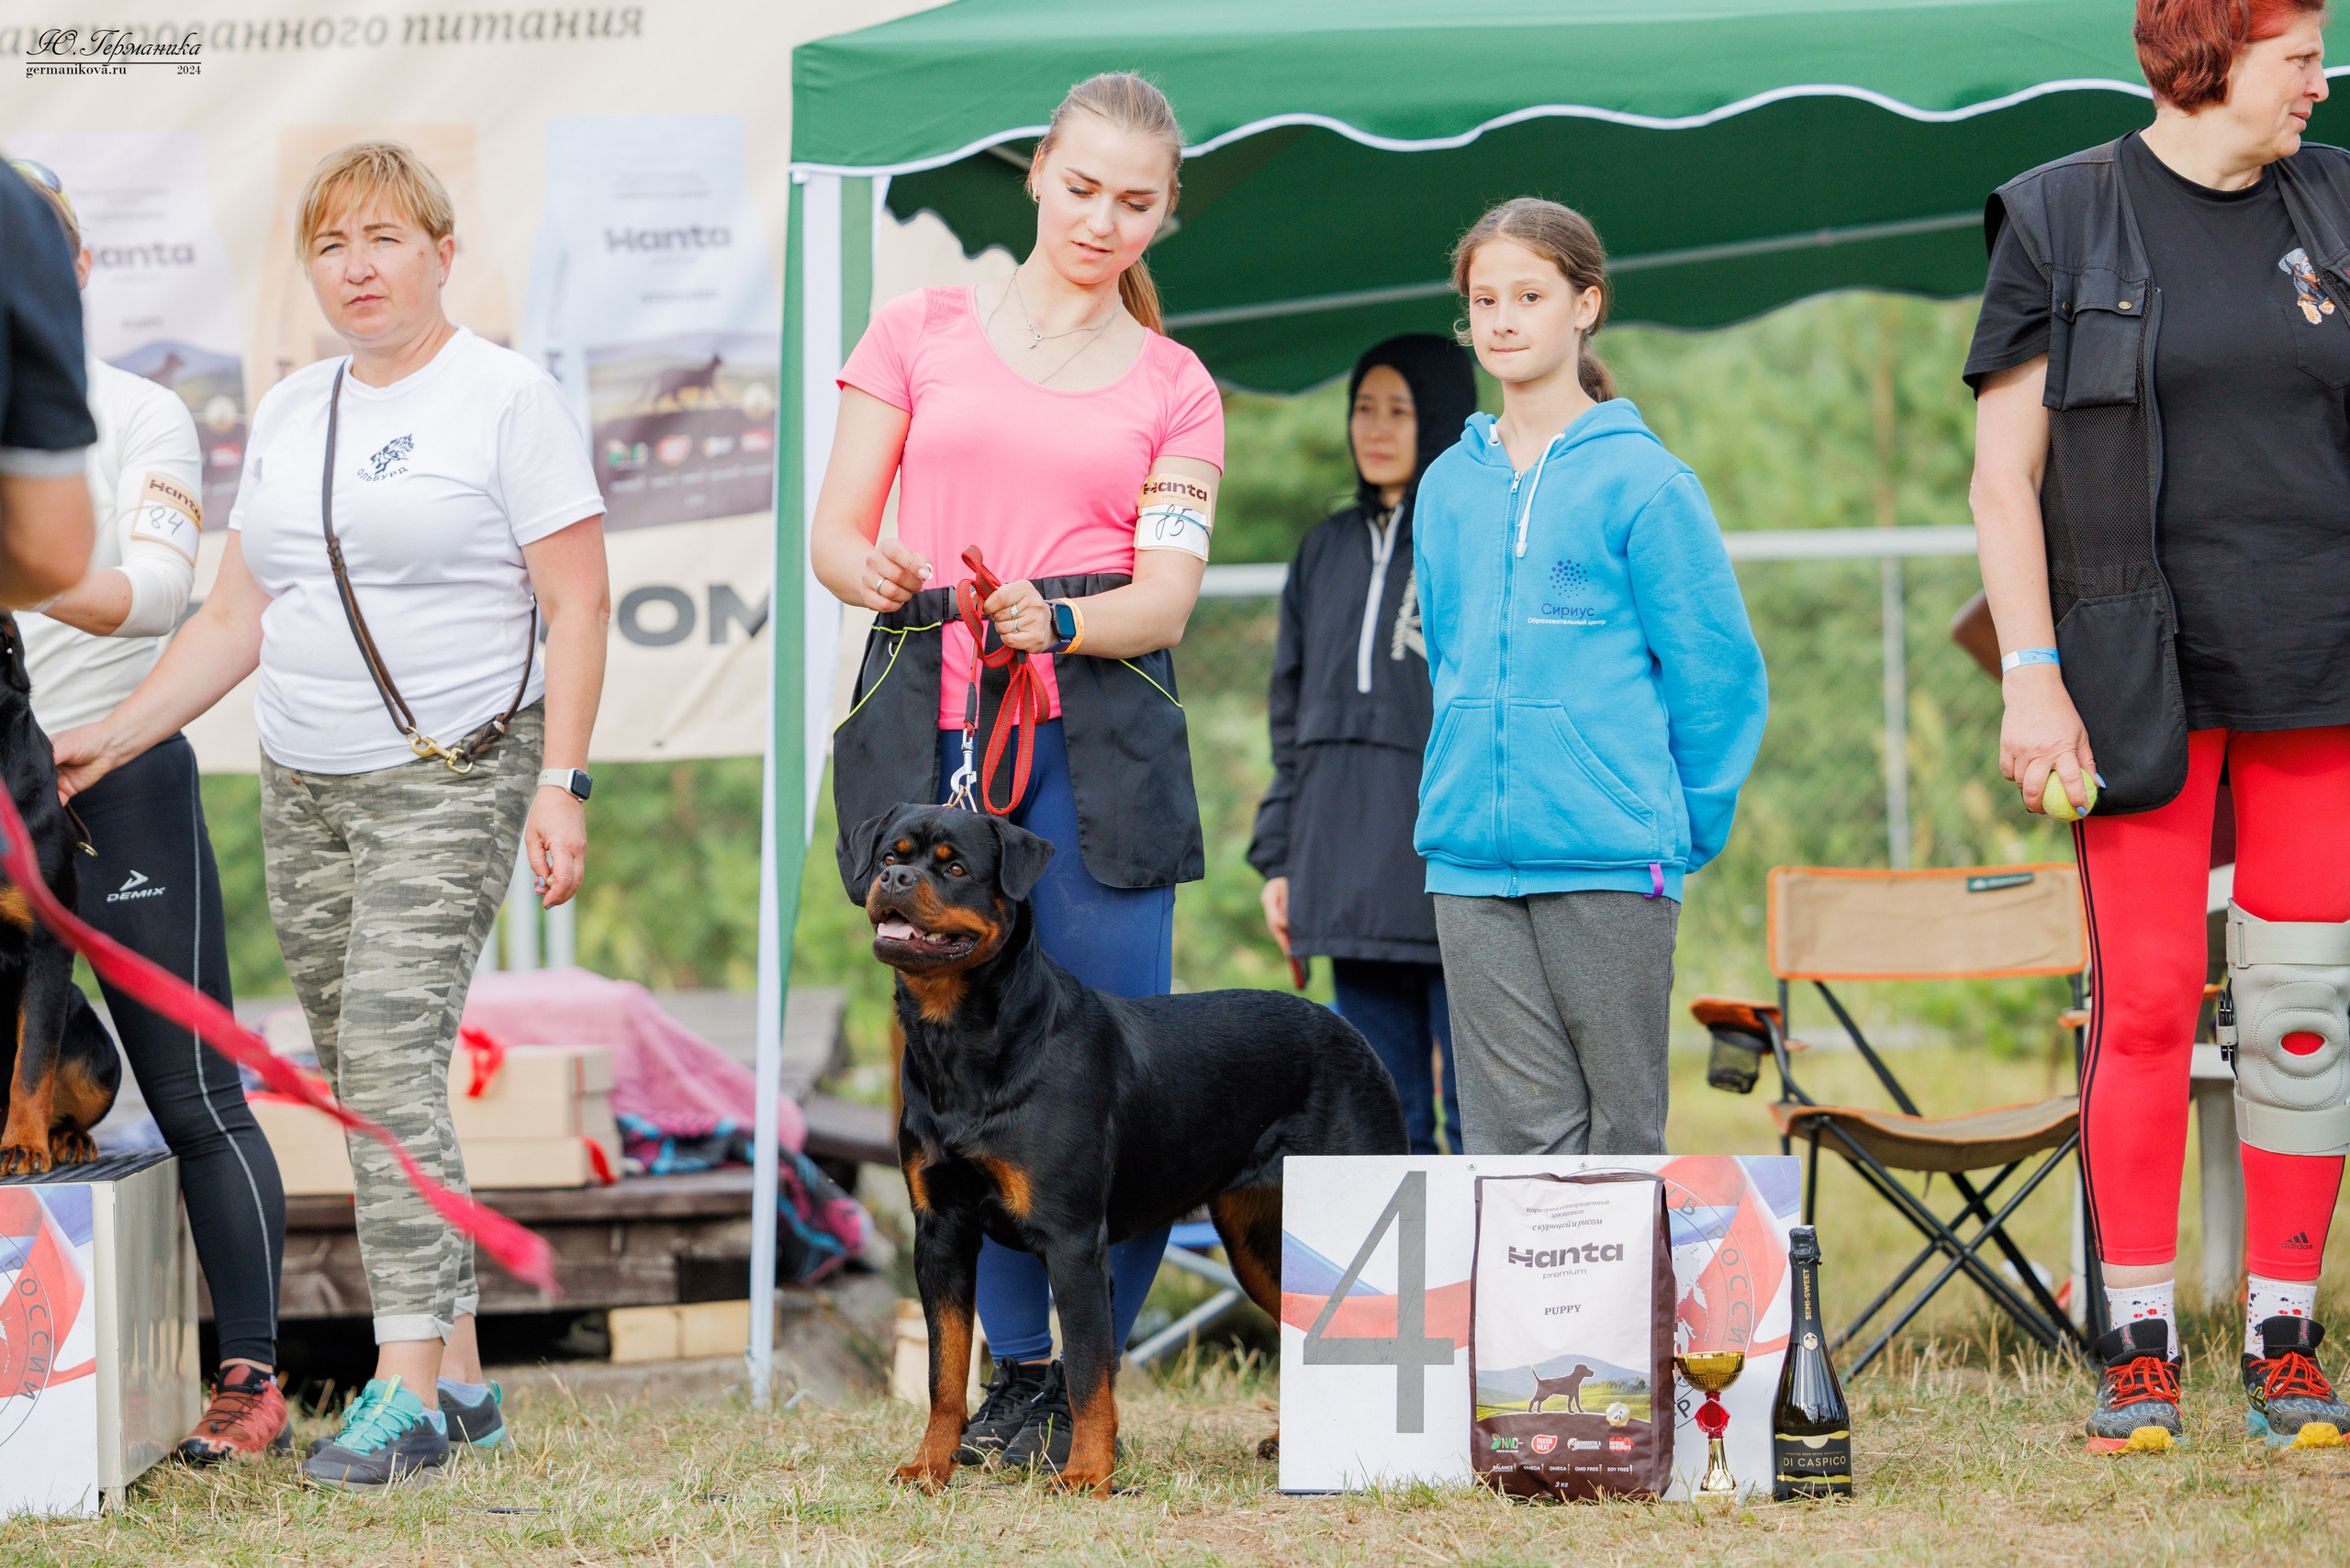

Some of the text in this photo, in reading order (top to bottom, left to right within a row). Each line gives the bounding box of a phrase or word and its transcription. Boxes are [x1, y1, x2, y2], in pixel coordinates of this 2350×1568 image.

[401, 6, 646, 46] питания
[604, 226, 732, 253] Hanta
[1143, 481, 1208, 502] Hanta
[150, 506, 184, 535] 84
[1528, 617, 1587, 625] Образовательный
[1541, 603, 1595, 619] Сириус
[106, 887, 166, 903] DEMIX
[1537, 1220, 1572, 1232] курицей
[1577, 1218, 1603, 1228] рисом
[1508, 1242, 1624, 1268] Hanta
[1542, 1269, 1587, 1280] premium
[1303, 1170, 1455, 1433] 4
[1803, 1269, 1812, 1320] SEMI-SWEET
[1544, 1304, 1583, 1316] PUPPY
[5, 1254, 50, 1402] РОССИИ
[1783, 1455, 1846, 1467] DI CASPICO
